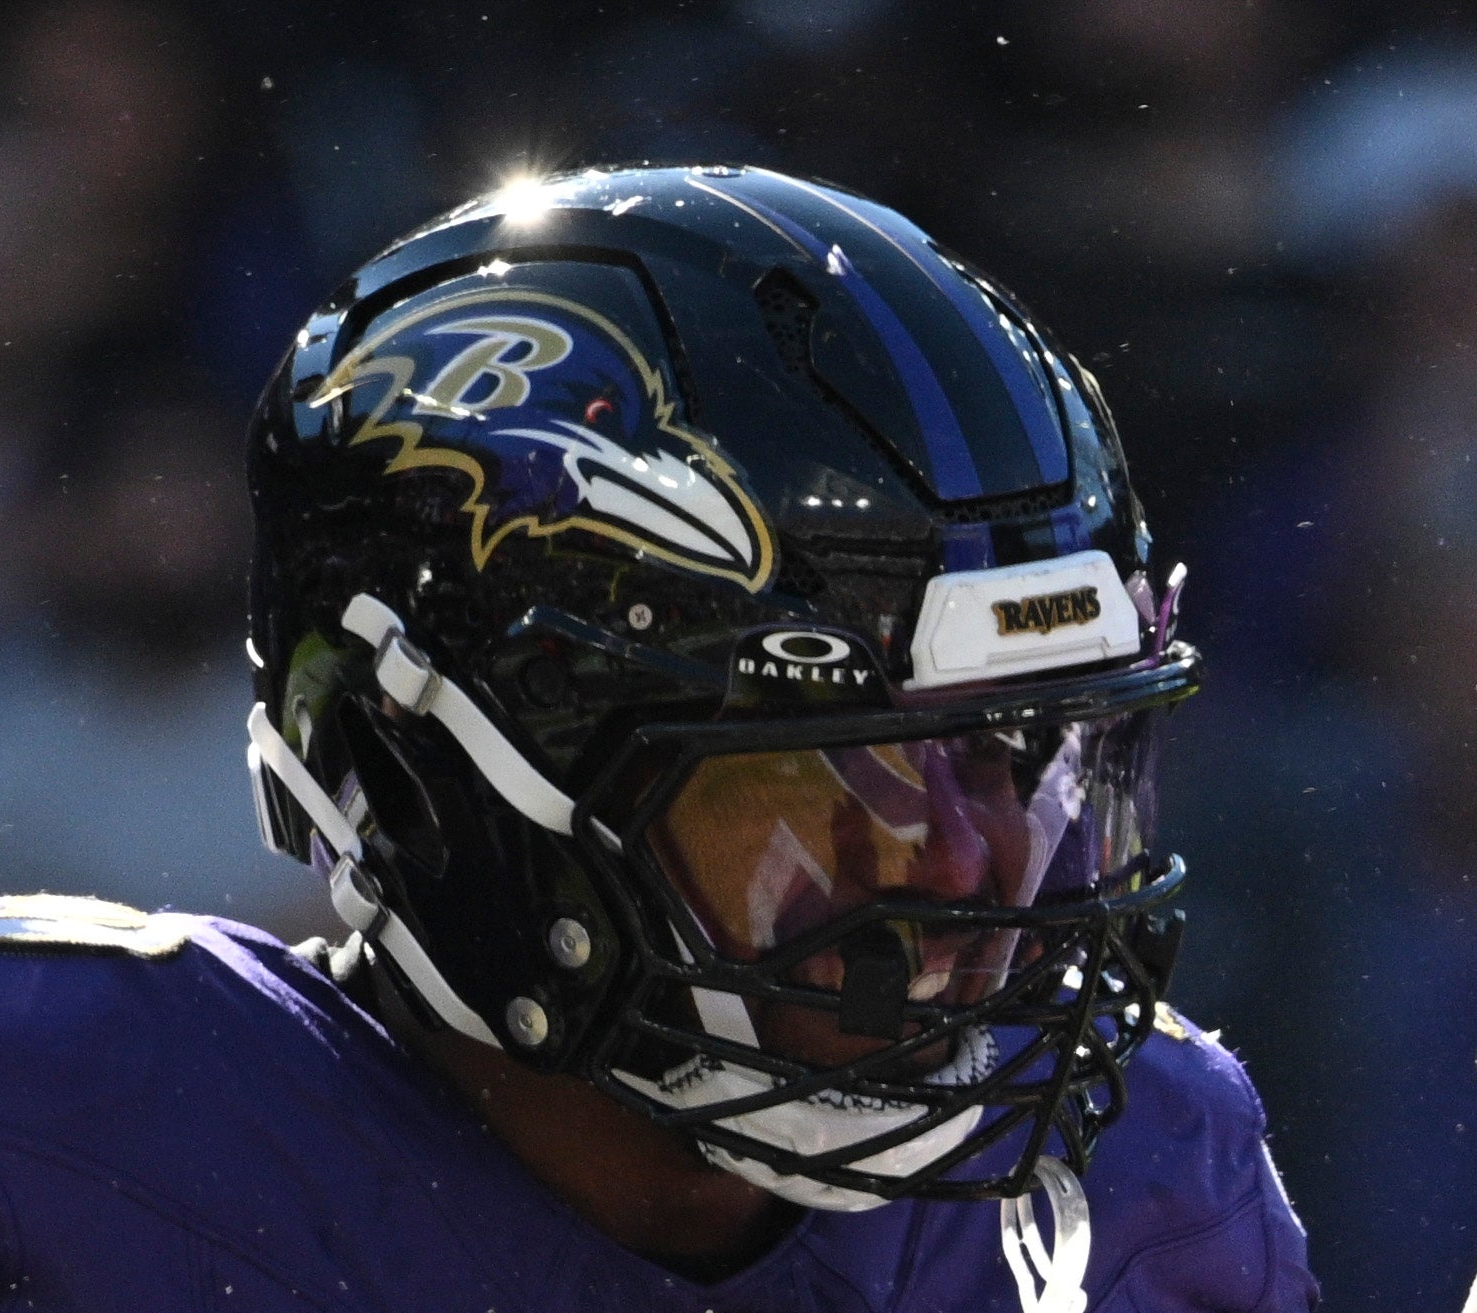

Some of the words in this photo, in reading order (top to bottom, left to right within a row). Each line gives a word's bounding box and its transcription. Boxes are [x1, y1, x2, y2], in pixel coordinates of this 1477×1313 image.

[411, 315, 574, 418] B
[991, 587, 1101, 636] RAVENS
[739, 657, 871, 686] OAKLEY
